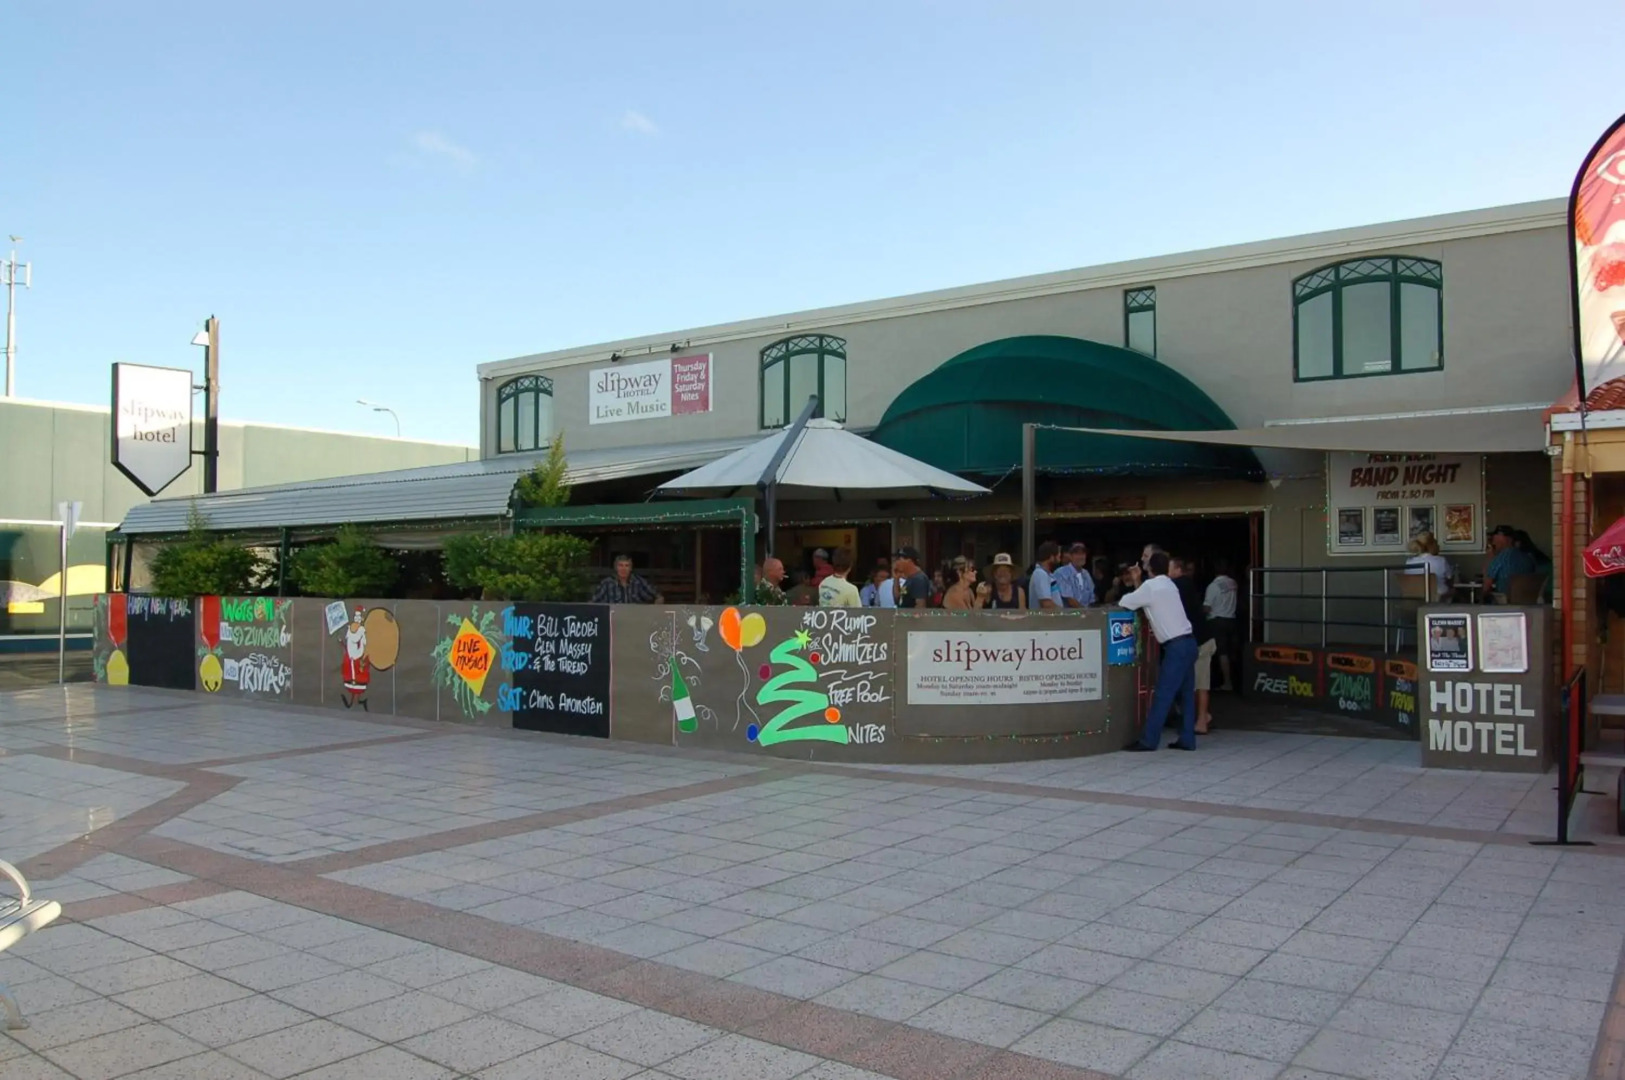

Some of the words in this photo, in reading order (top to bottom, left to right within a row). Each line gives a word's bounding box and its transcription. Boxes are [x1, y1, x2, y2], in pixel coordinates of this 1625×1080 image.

[673, 360, 707, 373] Thursday
[676, 371, 698, 384] Friday
[700, 370, 705, 380] &
[597, 372, 662, 399] slipway
[623, 388, 653, 398] HOTEL
[674, 381, 706, 393] Saturday
[680, 392, 699, 402] Nites
[123, 399, 184, 428] slipway
[596, 405, 622, 419] Live
[627, 400, 667, 415] Music
[133, 424, 176, 443] hotel
[1350, 466, 1399, 488] BAND
[1402, 462, 1461, 486] NIGHT
[1376, 489, 1400, 500] FROM
[128, 595, 150, 621] HAPPY
[150, 596, 168, 615] NEW
[169, 596, 191, 622] YEAR
[244, 626, 280, 648] ZUMBA
[457, 639, 480, 653] LIVE
[455, 653, 489, 671] MUSIC!
[932, 639, 1027, 671] slipway
[1030, 637, 1084, 662] hotel
[920, 675, 948, 683] HOTEL
[948, 675, 985, 683] OPENING
[1253, 671, 1288, 694] FREE
[1288, 674, 1314, 697] POOL
[1329, 672, 1371, 702] ZUMBA
[498, 682, 527, 713] SAT:
[827, 681, 855, 706] FREE
[1429, 681, 1535, 718] HOTEL
[848, 723, 886, 744] NITES
[1428, 719, 1538, 757] MOTEL
